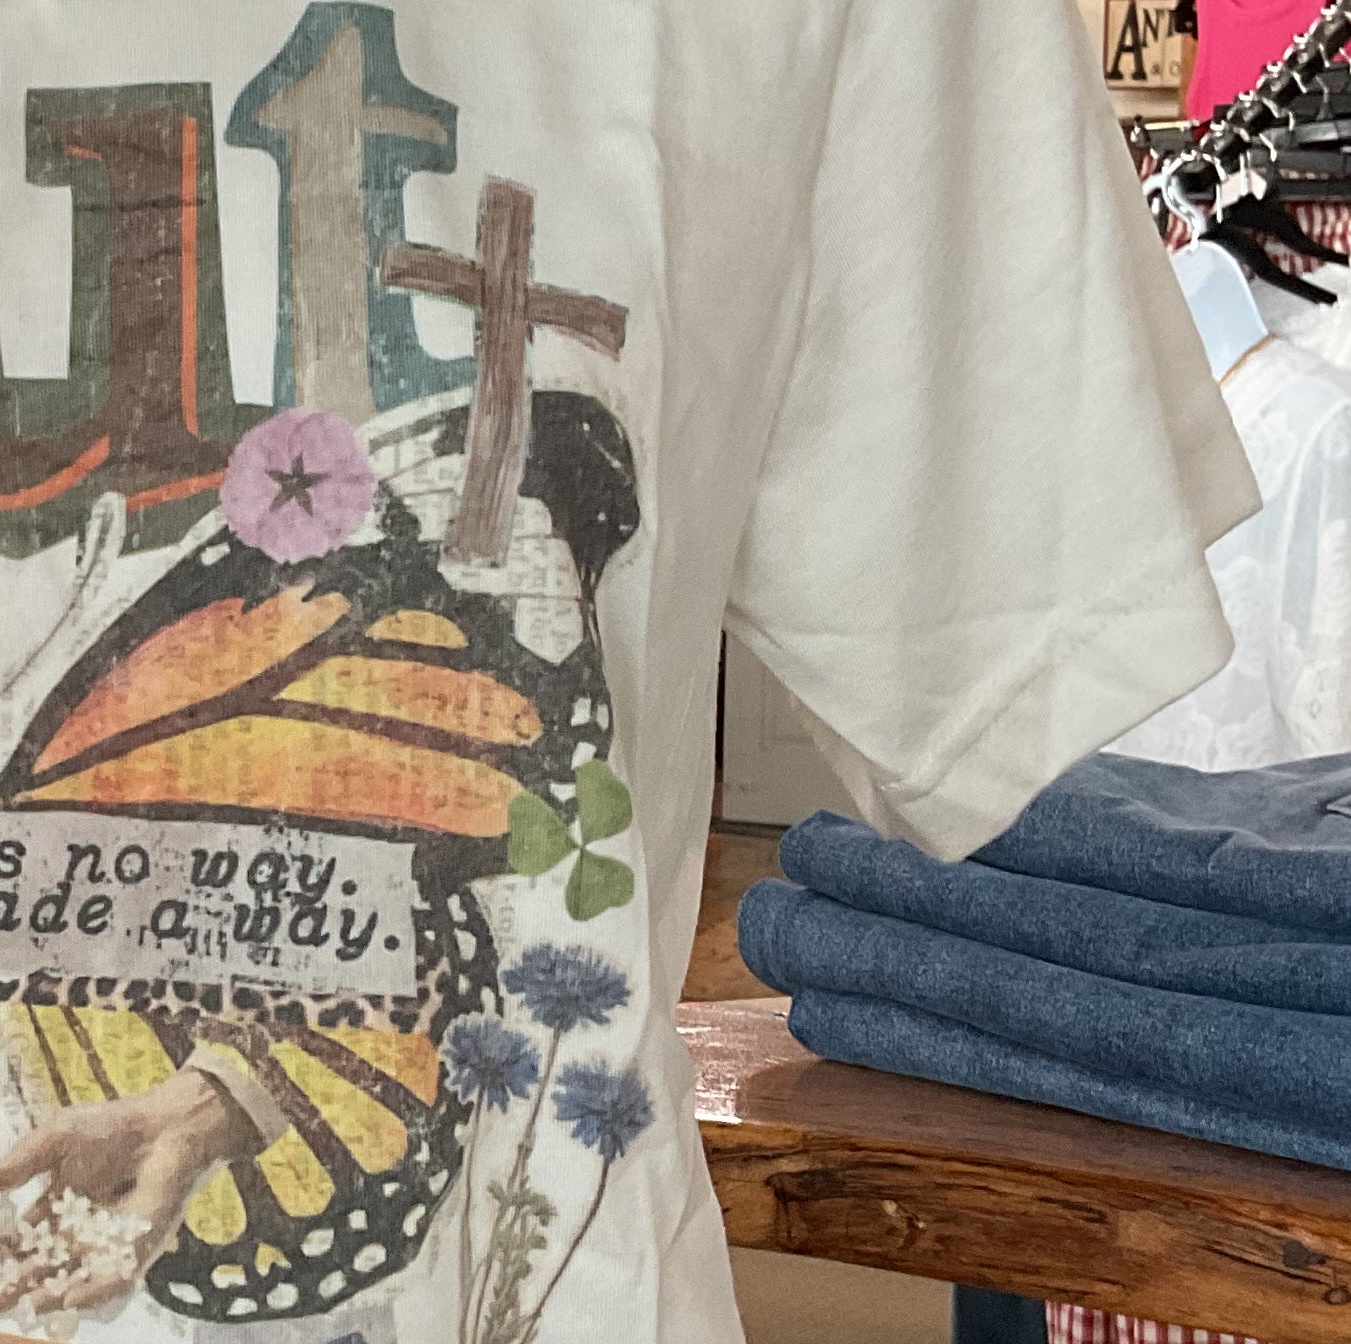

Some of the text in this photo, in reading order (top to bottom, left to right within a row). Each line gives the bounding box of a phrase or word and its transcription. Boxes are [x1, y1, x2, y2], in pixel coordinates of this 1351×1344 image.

[65, 842, 151, 885] no
[190, 846, 358, 905] way.
[151, 898, 192, 940] a
[232, 902, 401, 962] way.
